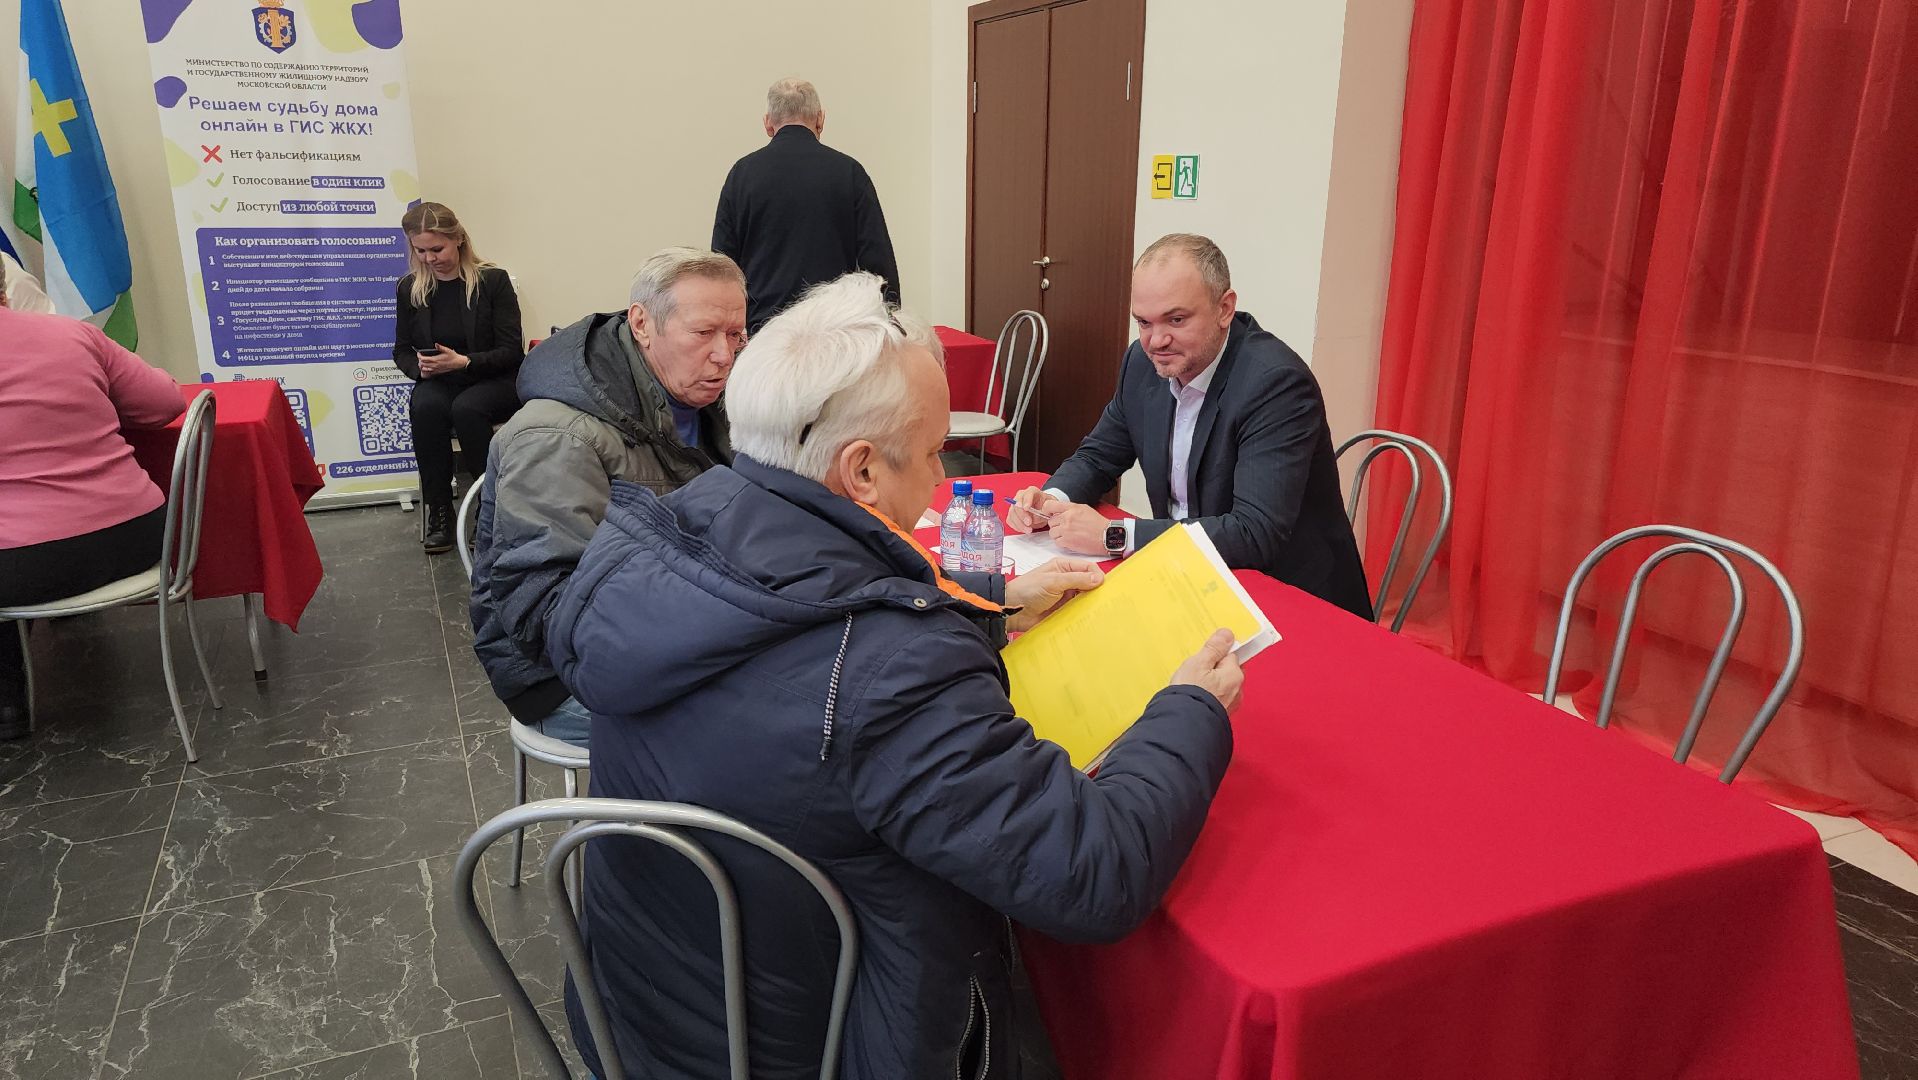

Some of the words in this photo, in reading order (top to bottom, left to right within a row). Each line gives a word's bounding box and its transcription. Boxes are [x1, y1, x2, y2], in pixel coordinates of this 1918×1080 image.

[185, 58, 250, 67] МИНИСТЕРСТВО
[263, 62, 320, 71] СОДЕРЖАНИЮ
[320, 65, 369, 73] ТЕРРИТОРИЙ
[195, 69, 277, 78] ГОСУДАРСТВЕННОМУ
[279, 72, 333, 81] ЖИЛИЩНОМУ
[334, 75, 369, 83] НАДЗОРУ
[237, 81, 291, 89] МОСКОВСКОЙ
[291, 83, 327, 91] ОБЛАСТИ
[189, 96, 261, 111] Решаем
[267, 100, 328, 117] судьбу
[335, 105, 378, 117] дома
[200, 118, 268, 132] онлайн
[274, 123, 284, 133] в
[290, 120, 325, 134] ГИС
[329, 121, 373, 136] ЖКХ!
[230, 150, 253, 159] Нет
[255, 151, 361, 163] фальсификациям
[232, 176, 310, 186] Голосование
[322, 179, 351, 188] один
[353, 180, 384, 188] клик
[236, 202, 280, 213] Доступ
[282, 204, 297, 212] из
[300, 201, 339, 212] любой
[341, 204, 375, 212] точки
[214, 236, 238, 247] Как
[239, 238, 320, 248] организовать
[321, 235, 397, 246] голосование?
[209, 255, 216, 265] 1
[211, 281, 220, 291] 2
[217, 316, 225, 326] 3
[221, 350, 231, 360] 4
[335, 466, 354, 474] 226
[354, 460, 409, 473] отделений
